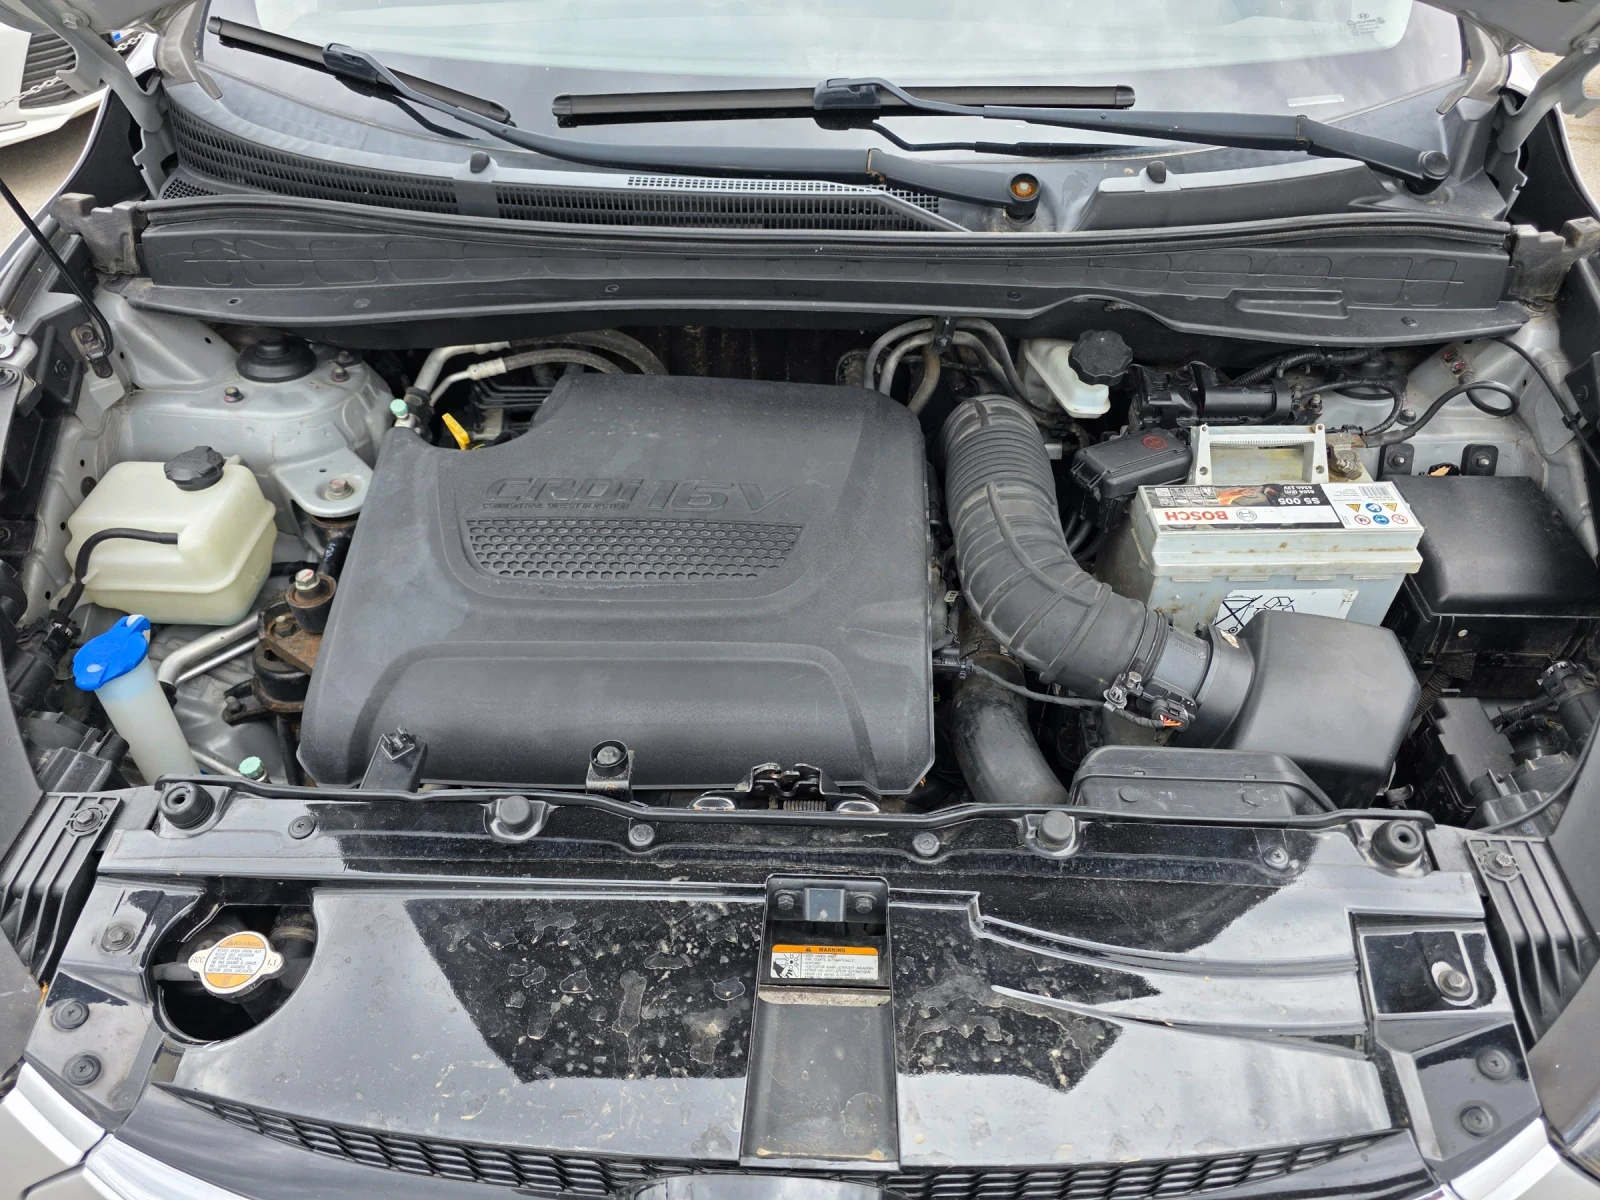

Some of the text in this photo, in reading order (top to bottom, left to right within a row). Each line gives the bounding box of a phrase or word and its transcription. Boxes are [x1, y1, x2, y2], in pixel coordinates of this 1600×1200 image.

[1277, 497, 1320, 505] S5 005
[1164, 510, 1229, 521] BOSCH
